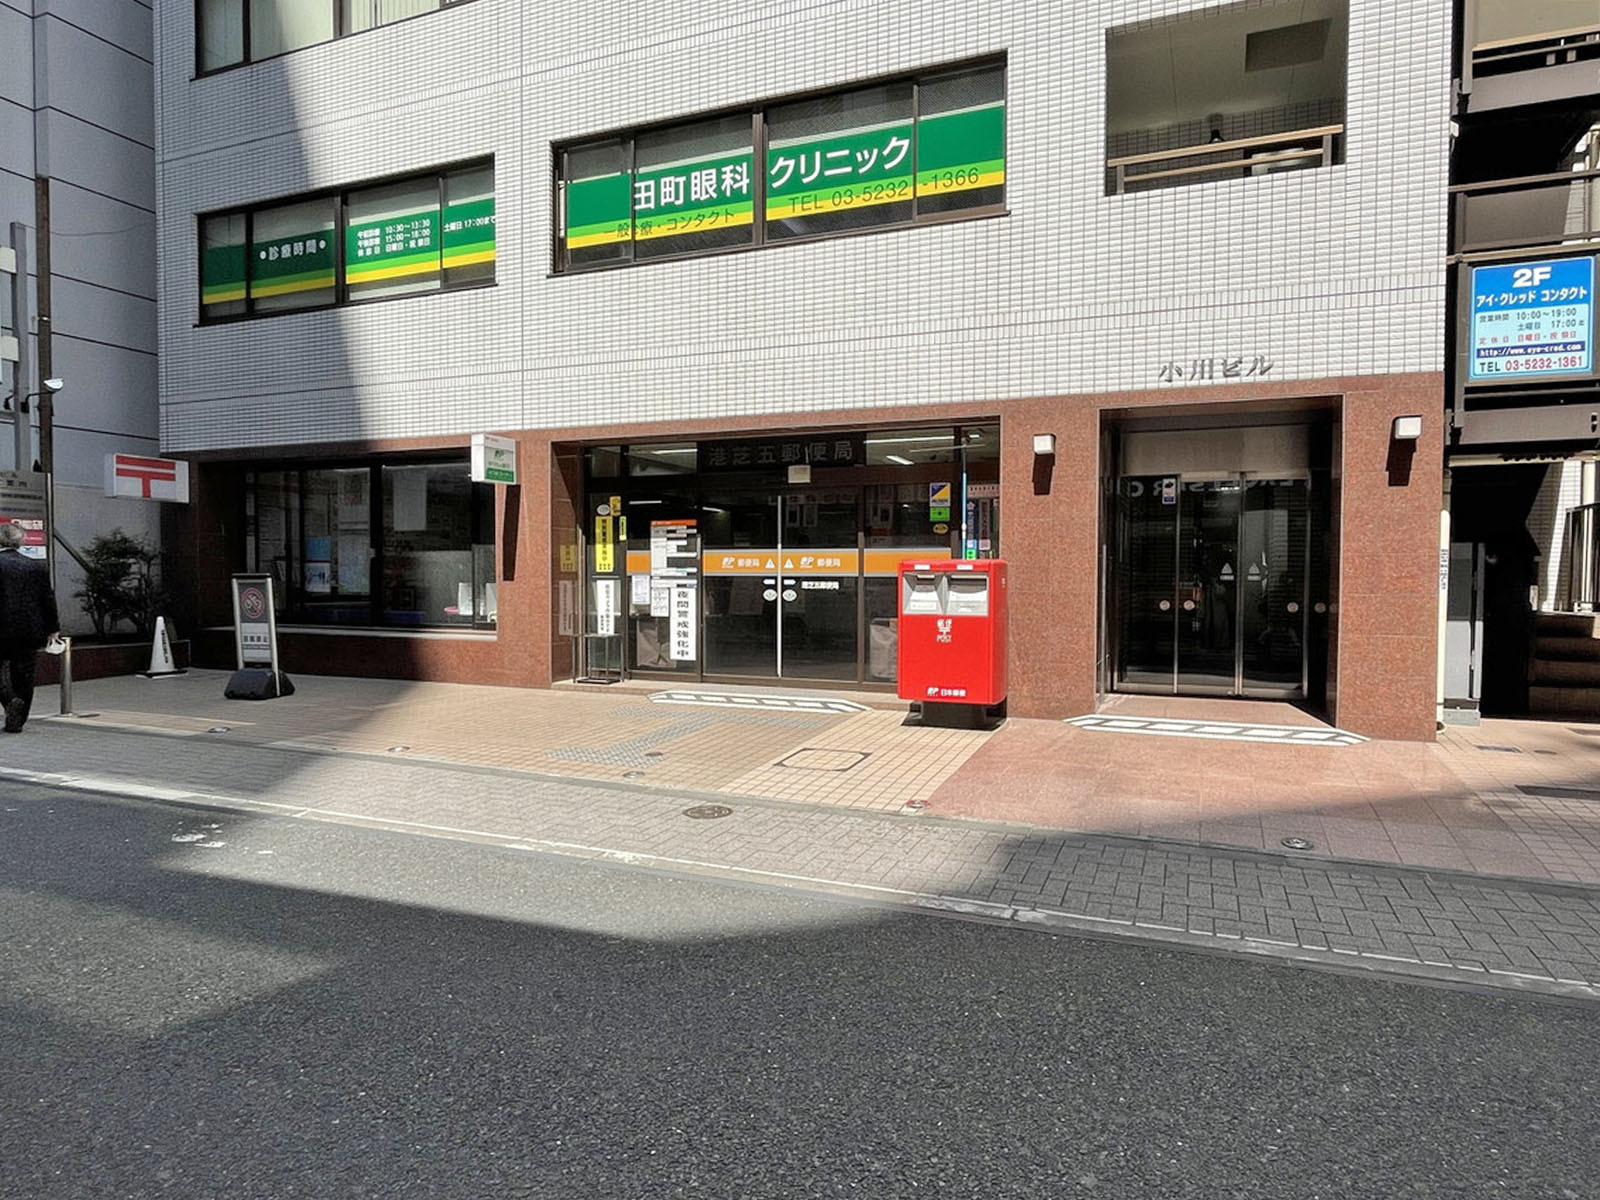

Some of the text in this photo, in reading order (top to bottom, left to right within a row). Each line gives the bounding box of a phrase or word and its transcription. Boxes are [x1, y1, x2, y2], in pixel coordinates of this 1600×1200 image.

[633, 135, 911, 211] 田町眼科 クリニック
[788, 194, 824, 214] TEL
[269, 239, 317, 261] 診療時間
[1512, 266, 1552, 288] 2F
[1476, 286, 1588, 307] アイ・クレッド コンタクト
[1551, 319, 1576, 329] 17:00
[1158, 356, 1274, 382] 小川ビル
[1480, 356, 1583, 373] TEL 03-5232-1361
